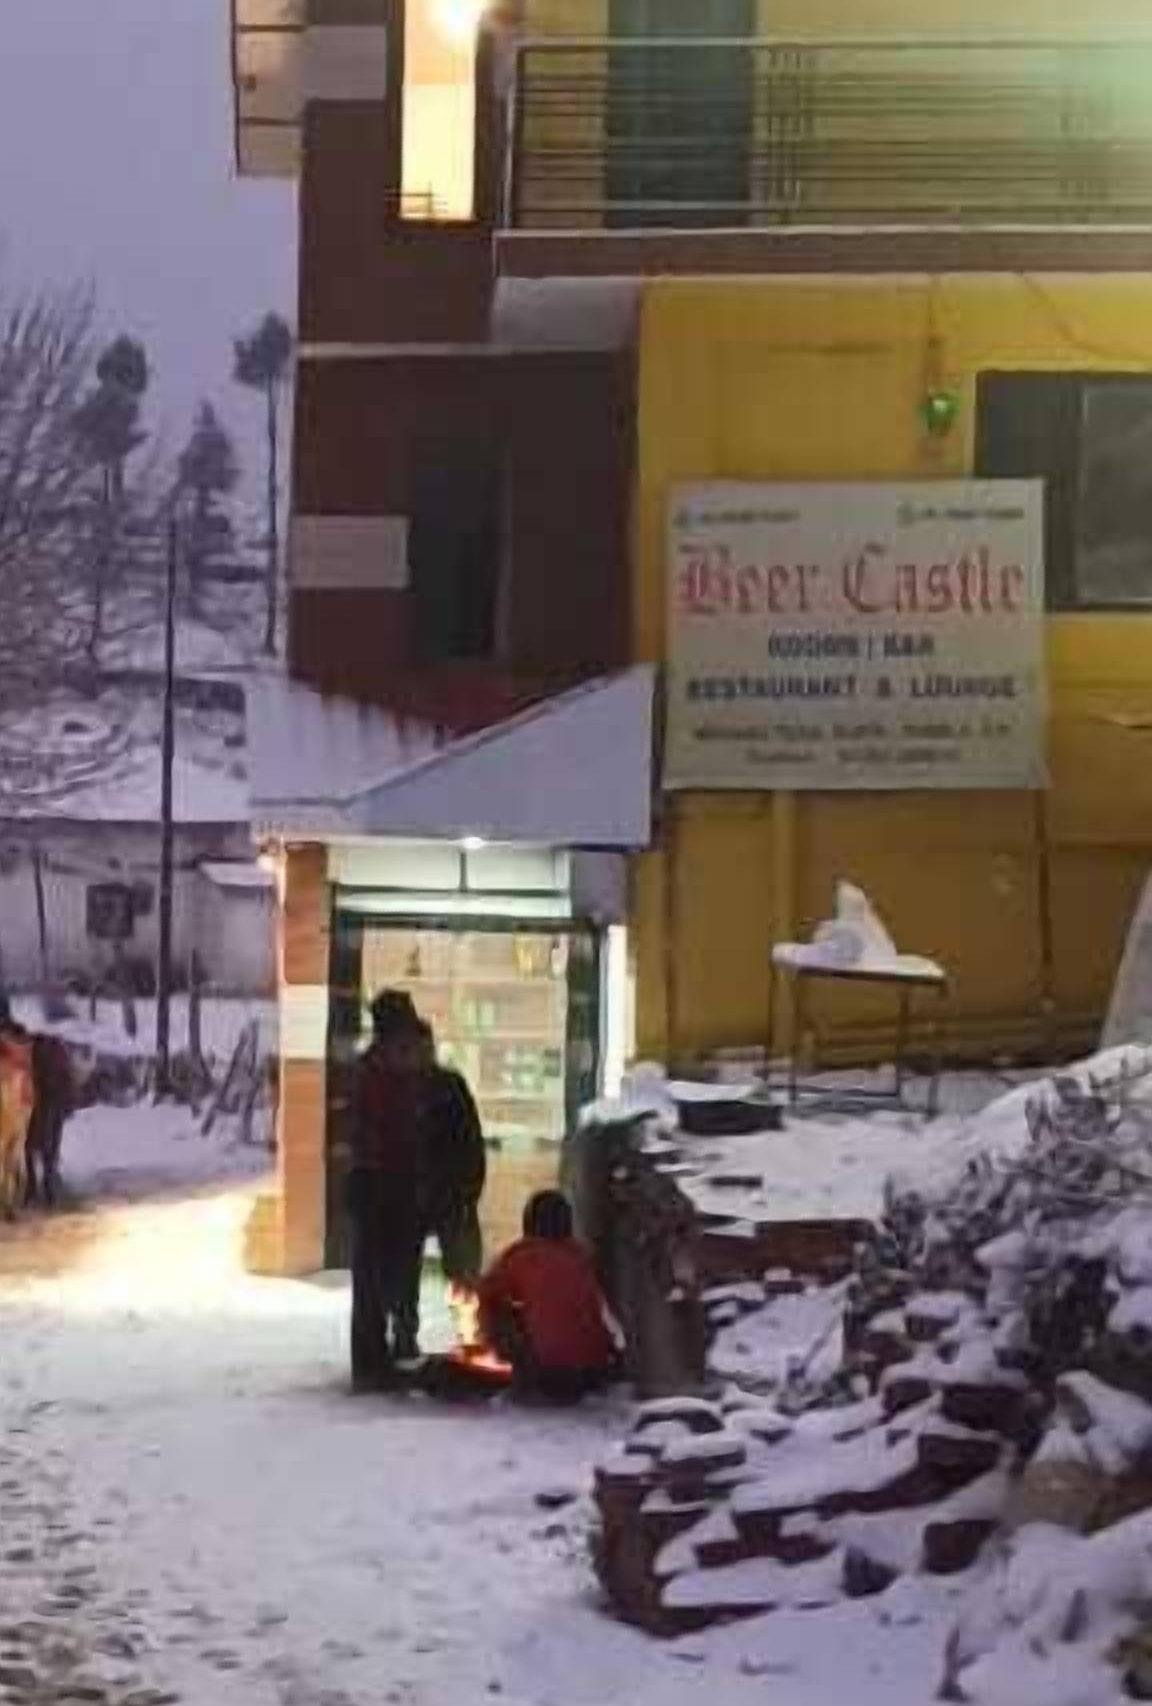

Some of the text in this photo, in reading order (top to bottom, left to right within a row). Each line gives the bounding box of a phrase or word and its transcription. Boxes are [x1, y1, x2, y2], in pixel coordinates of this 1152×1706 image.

[677, 542, 1026, 614] Beer Castle
[686, 675, 857, 701] RESTAURANT
